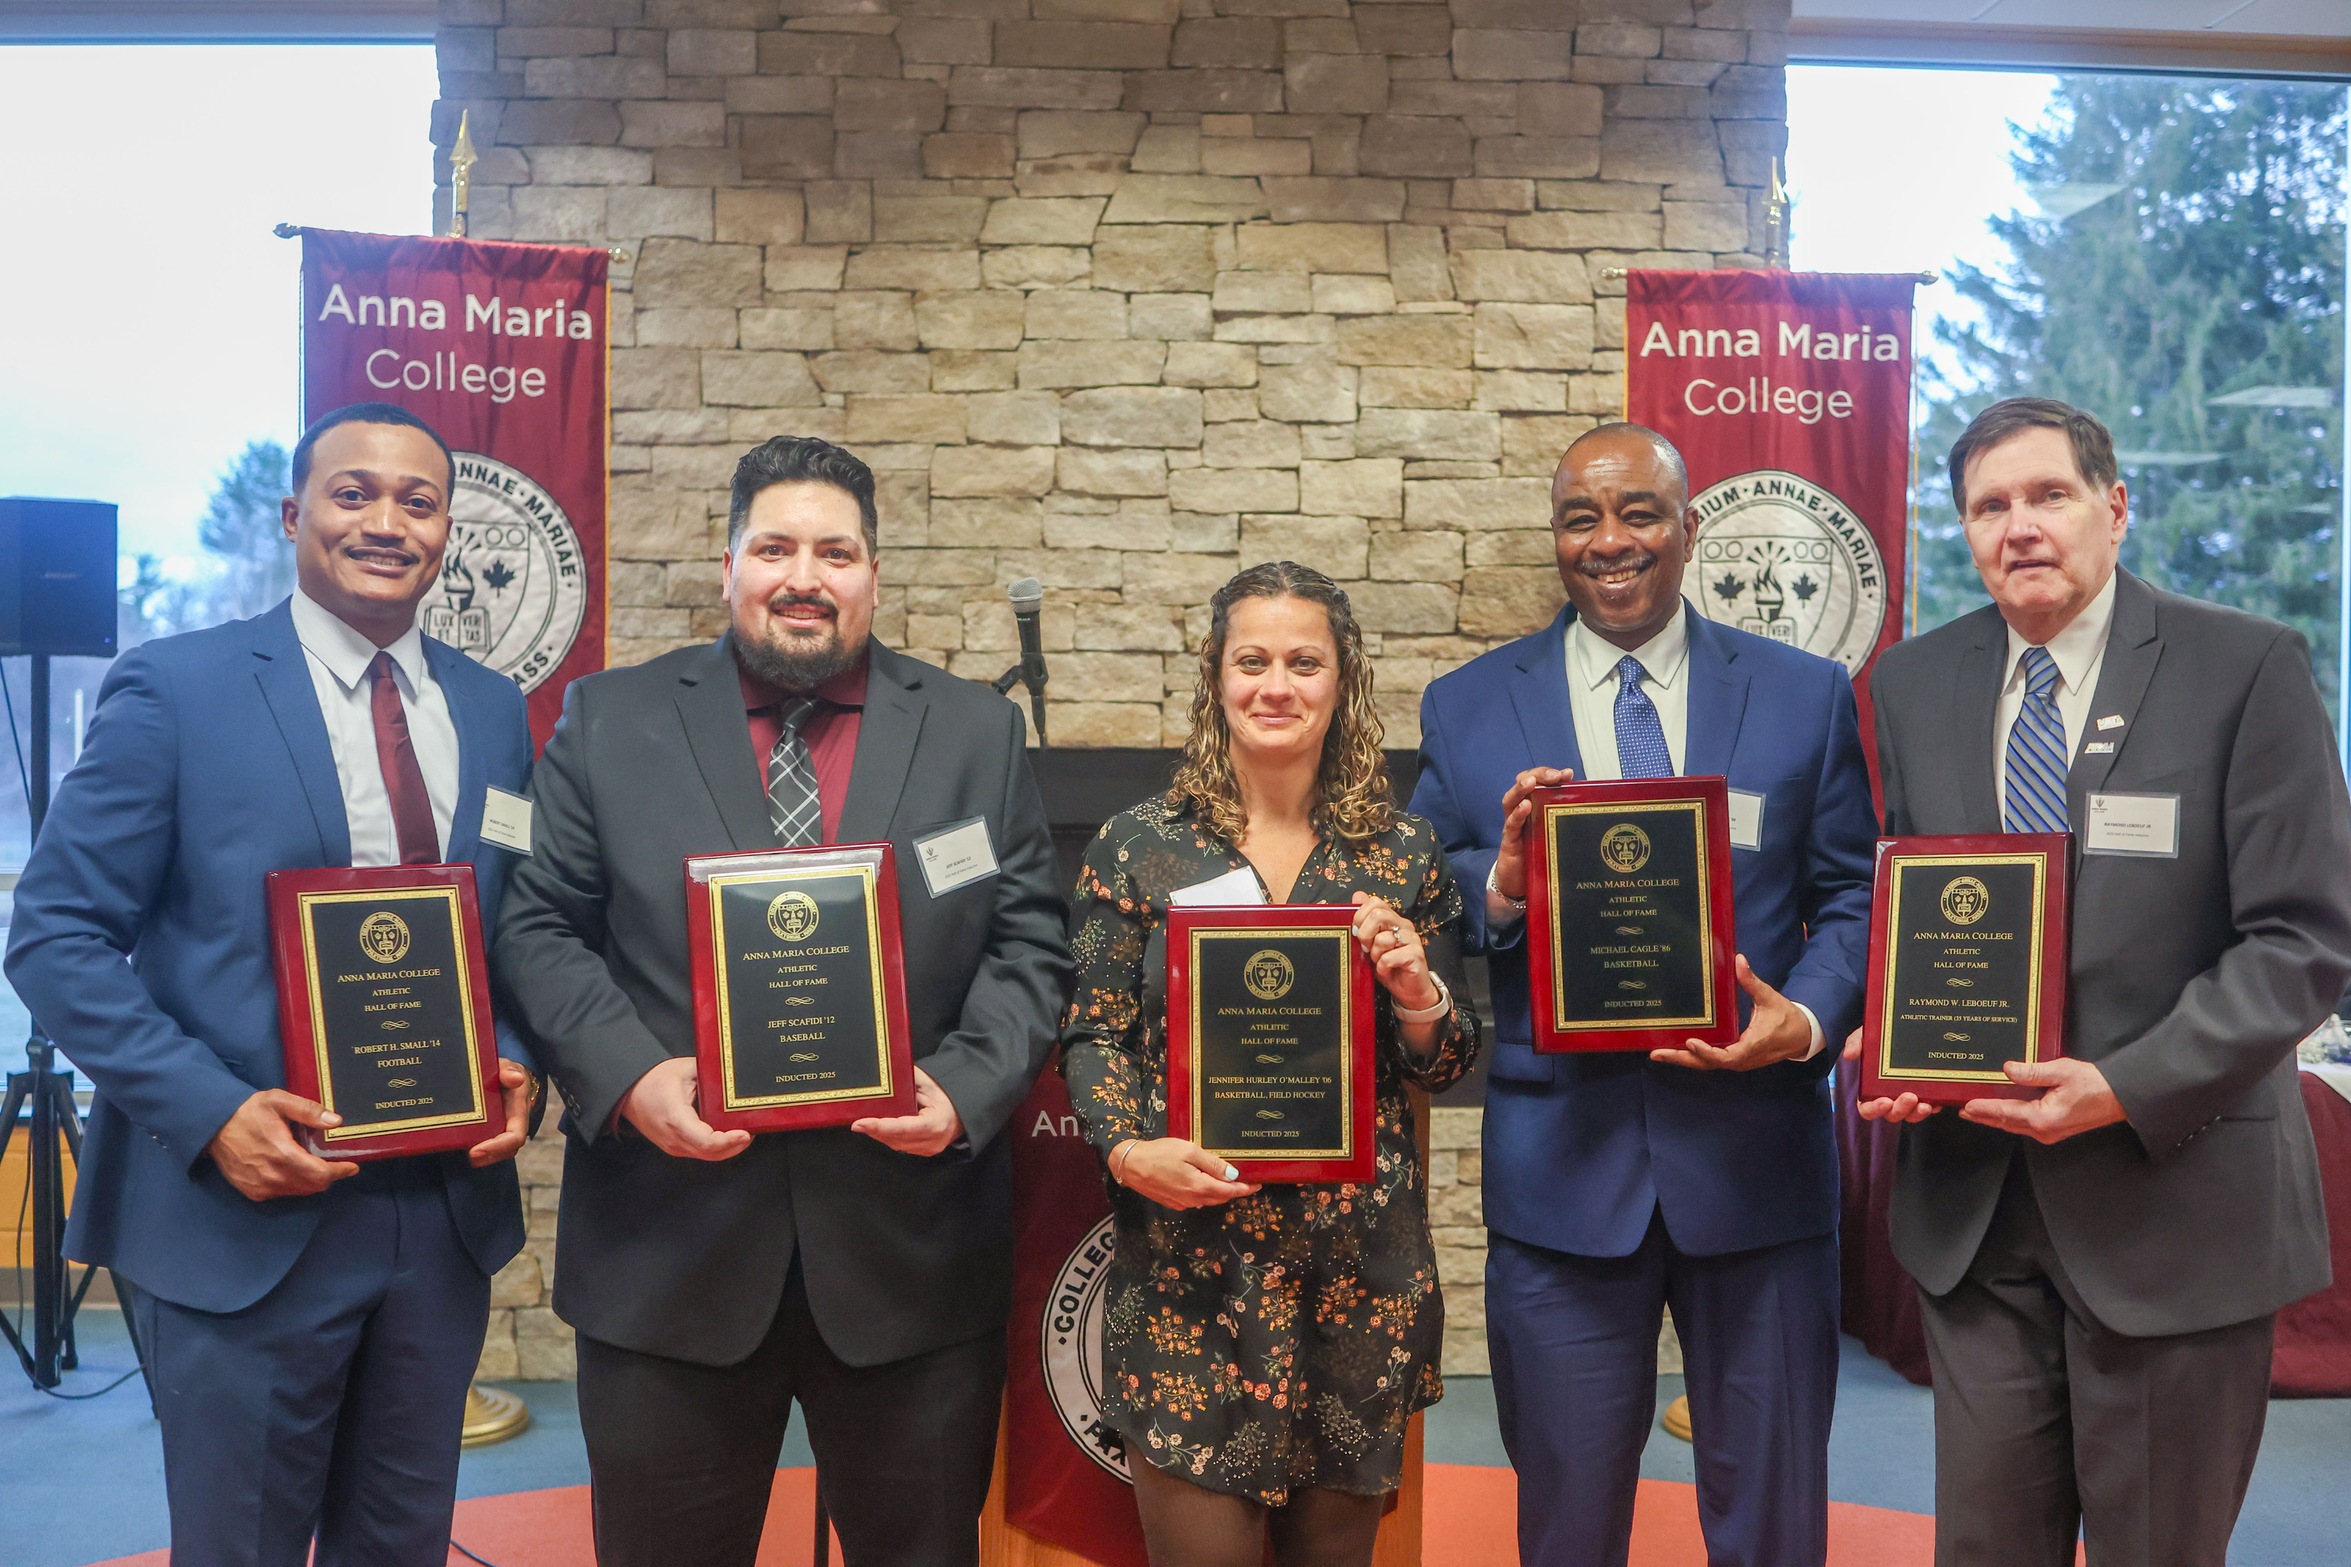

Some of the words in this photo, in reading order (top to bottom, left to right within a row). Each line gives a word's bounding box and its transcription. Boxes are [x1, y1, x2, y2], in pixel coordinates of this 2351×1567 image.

[319, 283, 446, 331] Anna
[465, 293, 593, 341] Maria
[1640, 321, 1761, 359] Anna
[1778, 321, 1900, 361] Maria
[365, 349, 547, 403] College
[1684, 376, 1853, 425] College
[460, 462, 518, 495] NNAE
[525, 495, 576, 577] MARIAE
[1753, 480, 1823, 511] ANNAE
[1828, 510, 1877, 589] MARIAE
[512, 652, 549, 685] ASS
[1637, 879, 1679, 887] COLLEGE
[1609, 896, 1647, 904] ATHLETIC
[1913, 932, 1939, 940] ANNA
[1940, 932, 1970, 940] MARIA
[1972, 932, 2013, 940] COLLEGE
[743, 951, 770, 961] ANNA
[772, 949, 804, 959] MARIA
[806, 946, 849, 956] COLLEGE
[1590, 946, 1629, 954] MICHAEL
[1630, 945, 1659, 953] CAGLE
[777, 965, 817, 974] ATHLETIC
[1603, 960, 1659, 968] BASKETBALL
[338, 974, 365, 983] ANNA
[367, 972, 398, 981] MARIA
[399, 968, 441, 978] COLLEGE
[769, 980, 791, 989] HALL
[792, 979, 804, 987] OF
[805, 977, 828, 986] FAME
[372, 988, 410, 997] ATHLETIC
[364, 1004, 386, 1012] HALL
[399, 1001, 421, 1009] FAME
[1909, 999, 1950, 1007] RAYMOND
[1962, 999, 1998, 1008] LEBOEUF
[1999, 1000, 2010, 1008] JR.
[1218, 1007, 1244, 1015] ANNA
[1246, 1007, 1278, 1015] MARIA
[1279, 1007, 1322, 1015] COLLEGE
[767, 1019, 787, 1029] JEFF
[788, 1017, 822, 1027] SCAFIDI
[823, 1016, 835, 1024] '12
[780, 1032, 825, 1043] BASEBALL
[354, 1044, 388, 1054] ROBERT
[390, 1043, 399, 1051] H.
[400, 1041, 429, 1050] SMALL
[430, 1039, 441, 1047] '14
[377, 1057, 422, 1068] FOOTBALL
[776, 1073, 818, 1083] INDUCTED
[1214, 1091, 1268, 1099] BASKETBALL,
[1269, 1091, 1291, 1099] FIELD
[1293, 1091, 1326, 1099] HOCKEY
[375, 1098, 416, 1109] INDUCTED
[417, 1097, 433, 1105] 2025
[1031, 1110, 1079, 1137] An
